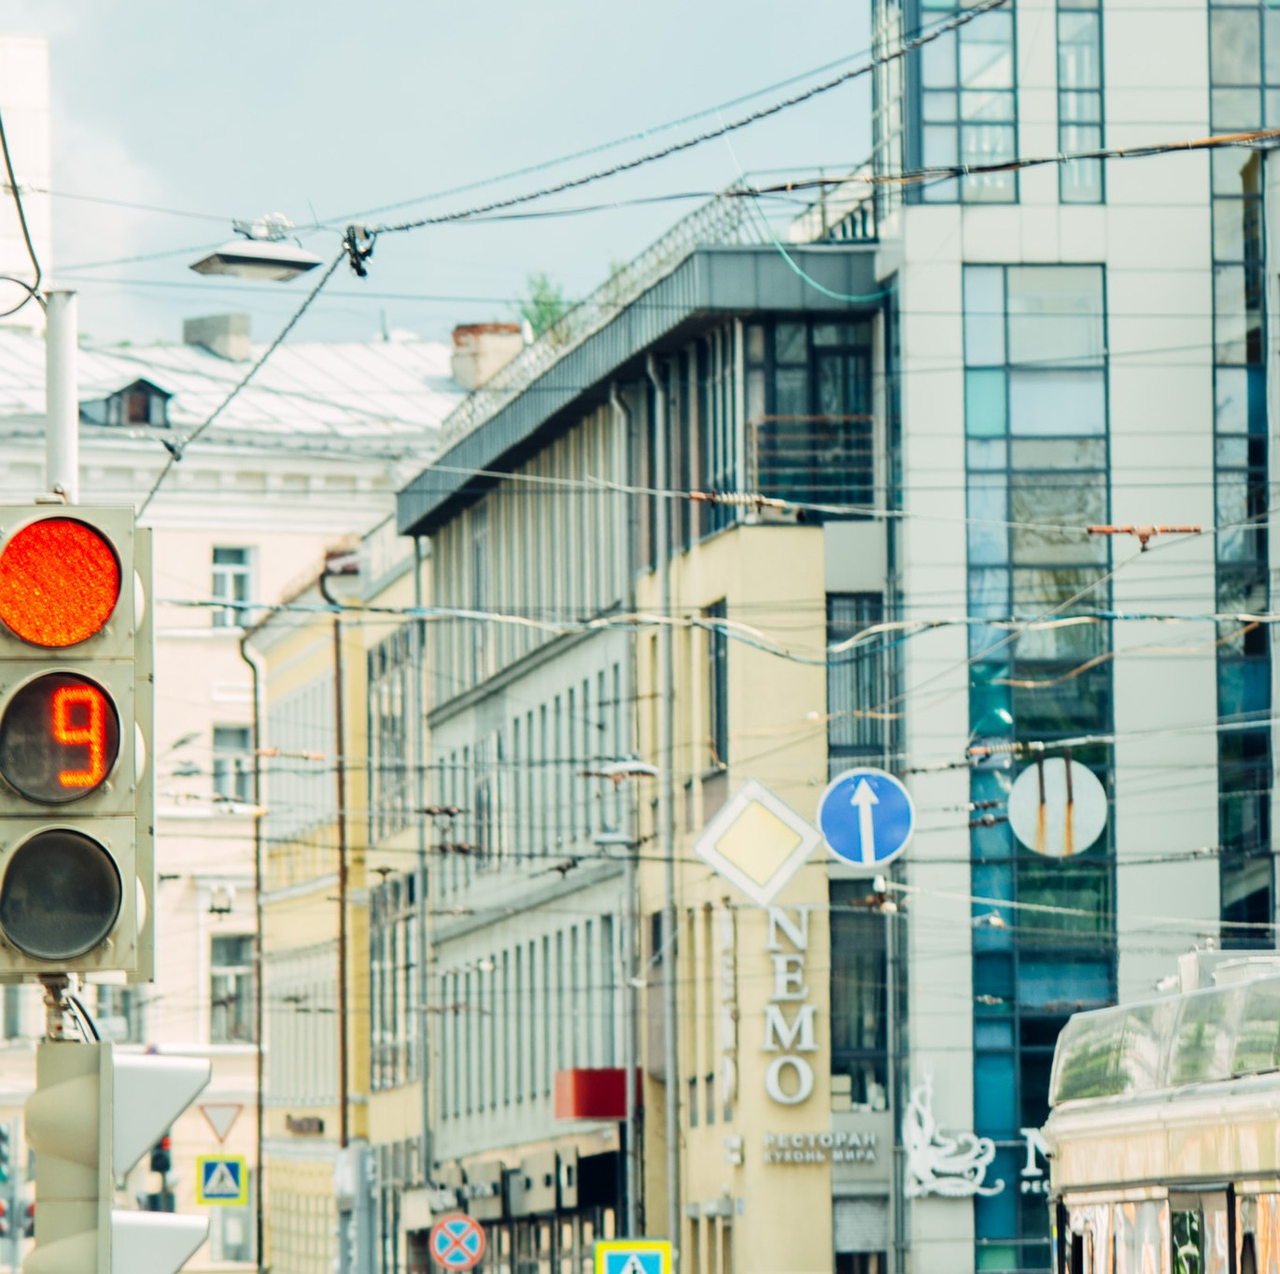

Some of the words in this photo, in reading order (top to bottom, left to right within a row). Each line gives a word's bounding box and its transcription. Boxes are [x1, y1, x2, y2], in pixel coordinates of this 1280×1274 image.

[52, 685, 105, 787] 9
[761, 905, 820, 1106] NEMO
[763, 1131, 876, 1148] РЕСТОРАН
[832, 1148, 876, 1163] МИРА
